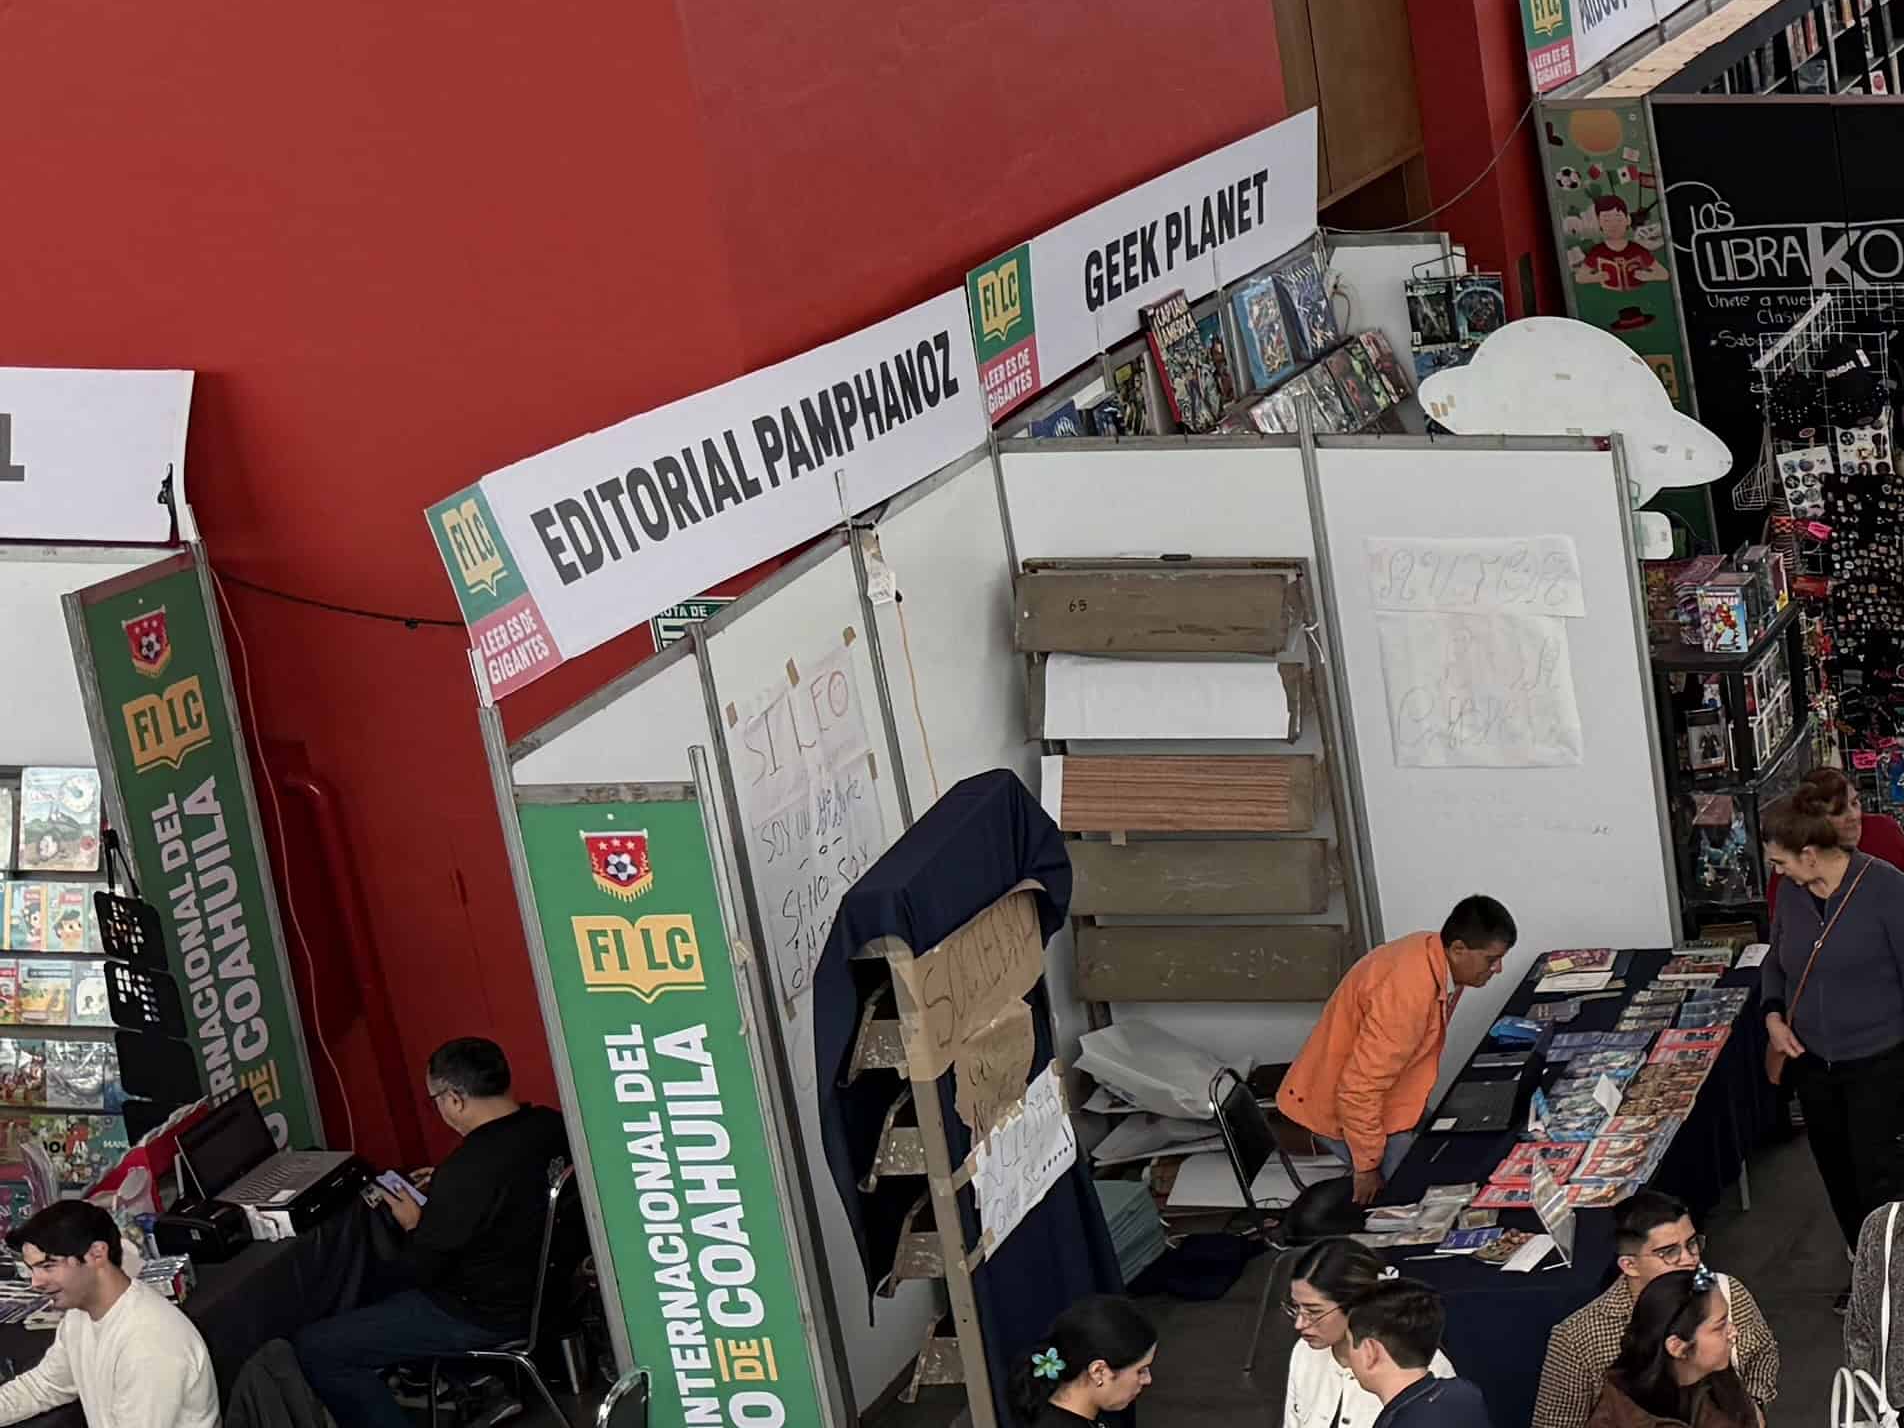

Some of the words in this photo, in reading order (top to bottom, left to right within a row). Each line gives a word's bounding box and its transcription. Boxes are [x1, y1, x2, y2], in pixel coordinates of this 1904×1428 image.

[1084, 219, 1161, 313] GEEK
[1165, 169, 1269, 271] PLANET
[1690, 200, 1735, 230] LOS
[529, 429, 763, 587] EDITORIAL
[751, 330, 960, 489] PAMPHANOZ
[480, 623, 509, 657] LEER
[693, 604, 709, 618] DE
[487, 635, 550, 685] GIGANTES
[152, 791, 192, 873] DEL
[181, 775, 272, 1063] COAHUILA
[168, 882, 238, 1108] ERNACIONAL
[603, 1023, 657, 1103] DEL
[653, 1023, 767, 1330] COAHUILA
[732, 1338, 767, 1382] DE
